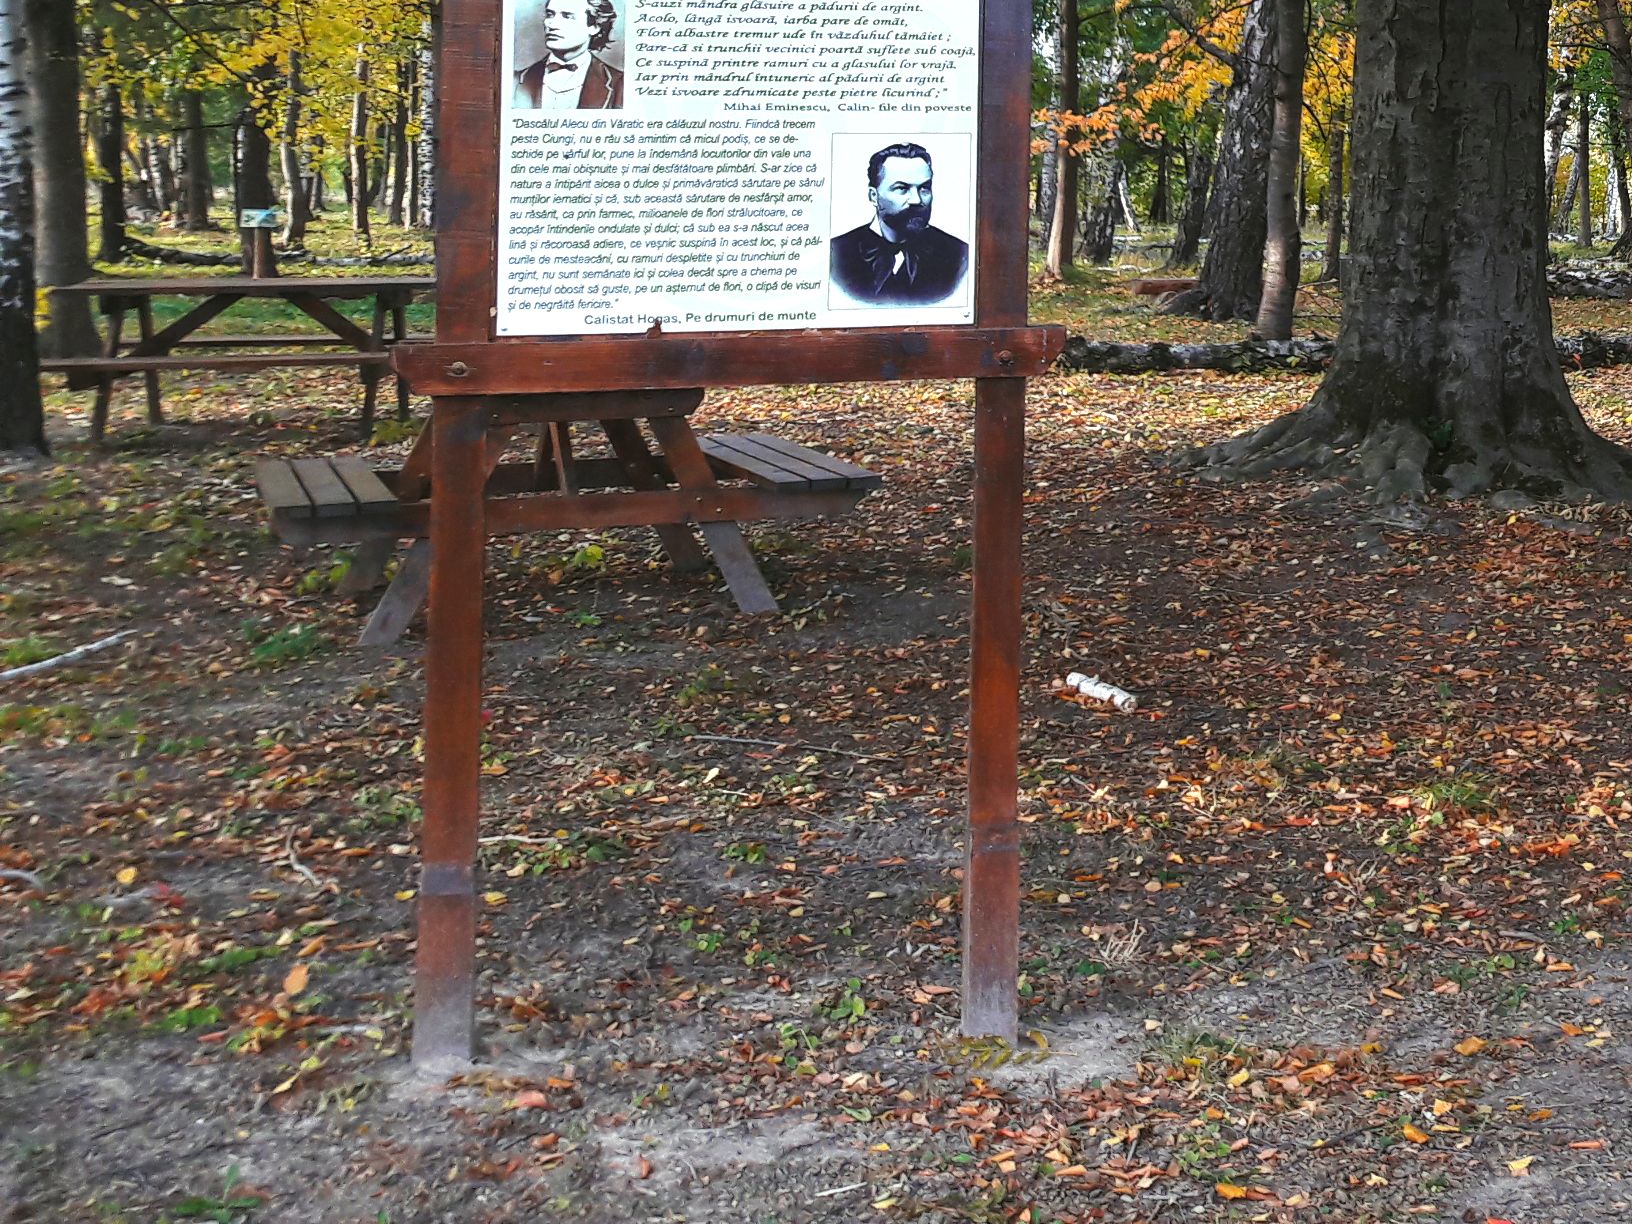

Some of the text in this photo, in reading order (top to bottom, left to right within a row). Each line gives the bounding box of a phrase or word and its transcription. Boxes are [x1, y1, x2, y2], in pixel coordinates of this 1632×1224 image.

[635, 0, 683, 8] S-auzi
[862, 2, 877, 11] de
[784, 15, 817, 24] iarba
[820, 19, 850, 27] pare
[854, 16, 869, 25] de
[636, 27, 671, 37] Flori
[675, 28, 729, 37] albastre
[783, 29, 806, 38] ude
[707, 43, 762, 52] trunchii
[867, 45, 910, 57] suflete
[914, 45, 936, 54] sub
[636, 58, 653, 67] Ce
[711, 59, 759, 70] printre
[841, 59, 896, 71] glasului
[900, 59, 918, 68] lor
[635, 73, 658, 81] Iar
[659, 72, 689, 84] prin
[819, 73, 834, 82] al
[887, 73, 902, 82] de
[906, 74, 944, 86] argint
[635, 86, 668, 96] Vezi
[672, 87, 720, 96] isvoare
[723, 87, 799, 96] zdrumicate
[802, 89, 837, 99] peste
[840, 88, 877, 99] pietre
[879, 103, 897, 111] file
[901, 103, 921, 111] din
[925, 105, 971, 113] poveste
[584, 315, 634, 324] Calistat
[686, 313, 701, 322] Pe
[705, 312, 754, 322] drumuri
[758, 312, 774, 321] de
[778, 311, 816, 320] munte
